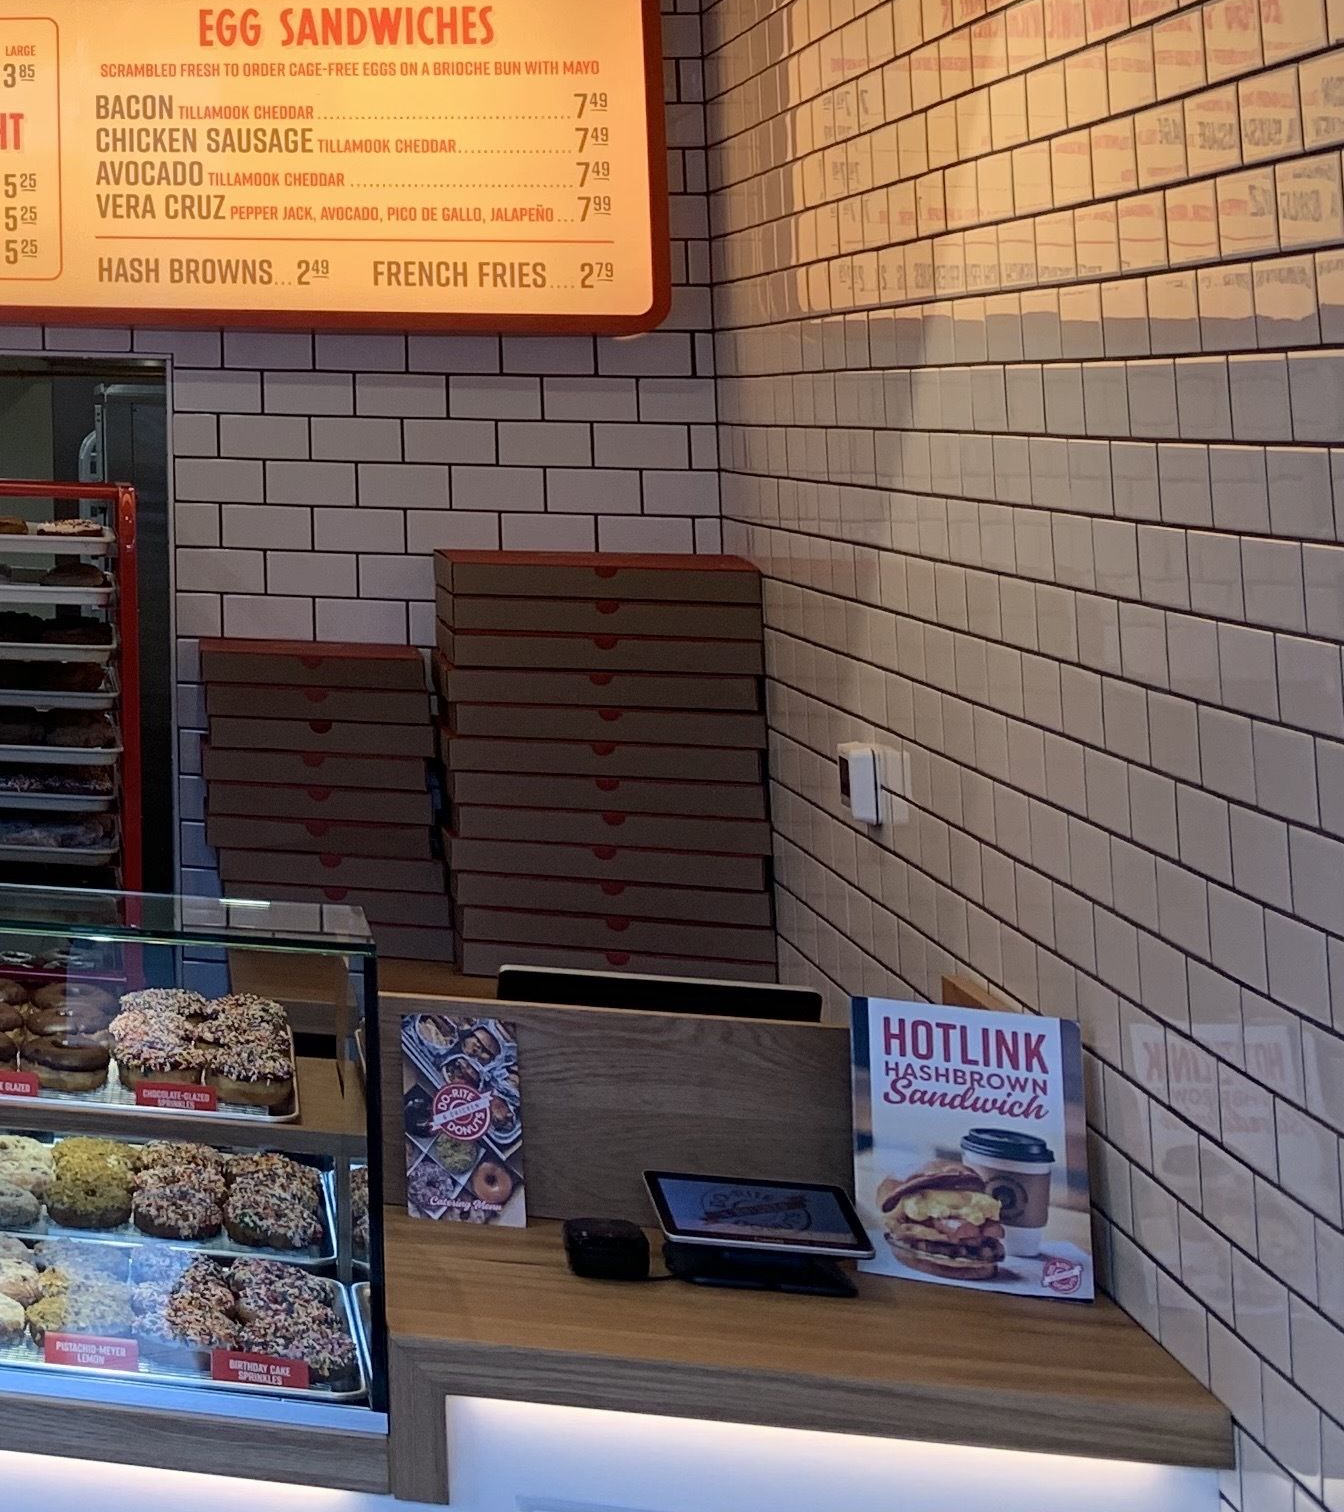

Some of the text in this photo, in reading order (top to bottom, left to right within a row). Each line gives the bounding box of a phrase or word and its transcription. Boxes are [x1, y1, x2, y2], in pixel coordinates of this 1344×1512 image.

[199, 6, 494, 47] EGG SANDWICHES
[5, 46, 36, 56] LARGE
[100, 61, 600, 77] SCRAMBLED FRESH TO ORDER CAGE-FREE EGGS ON A BRIOCHE BUN WITH MAYO
[95, 95, 173, 119] BACON
[178, 105, 250, 119] TILLAMOOK
[254, 105, 313, 119] CHEDDAR
[95, 128, 198, 153] CHICKEN
[206, 129, 313, 153] SAUSAGE
[317, 138, 391, 153] TILLAMOOK
[394, 139, 456, 154] CHEDDAR
[95, 162, 203, 186] AVOCADO
[208, 172, 280, 186] TILLAMOOK
[284, 172, 345, 187] CHEDDAR
[95, 194, 156, 219] VERA
[164, 194, 225, 220] CRUZ
[230, 206, 279, 221] PEPPER
[282, 206, 316, 222] JACK,
[320, 206, 383, 223] AVOCADO,
[387, 207, 417, 222] PICO
[421, 207, 438, 222] DE
[441, 207, 486, 224] GALLO,
[490, 205, 554, 223] JALAPEÑO
[98, 258, 160, 283] HASH
[169, 259, 274, 285] BROWNS
[372, 261, 469, 286] FRENCH
[478, 262, 547, 288] FRIES
[883, 1016, 1049, 1074] HOTLINK
[885, 1061, 1048, 1096] HASHBROWN
[438, 1088, 475, 1110] DO-RITE
[883, 1076, 1048, 1119] Sandwich
[447, 1112, 485, 1136] DONUTS
[430, 1196, 472, 1212] Catering
[56, 1341, 126, 1357] PISTACHIO-MEYER
[77, 1354, 105, 1365] LEMON
[229, 1359, 290, 1377] BIRTHDAY CAKE
[238, 1372, 282, 1386] SPRINKLES
